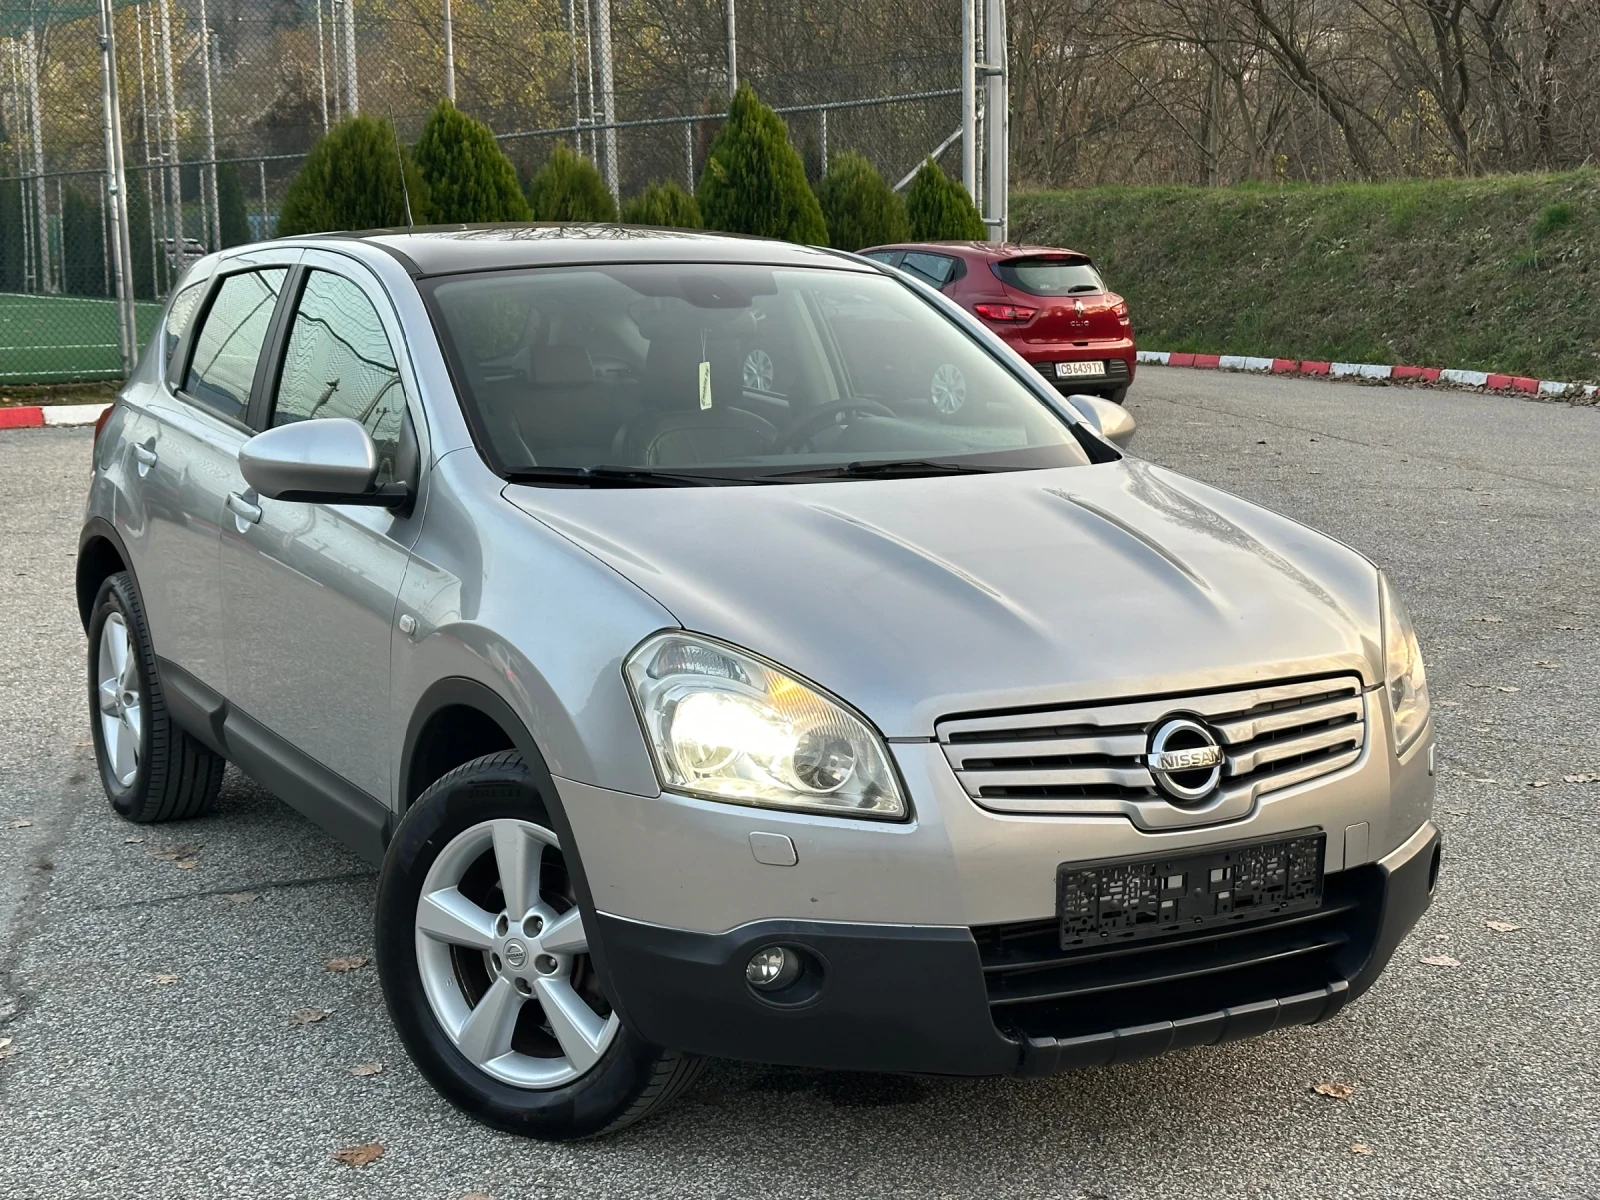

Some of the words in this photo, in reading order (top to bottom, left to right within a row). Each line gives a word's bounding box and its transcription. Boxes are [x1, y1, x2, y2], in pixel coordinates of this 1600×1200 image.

[1061, 364, 1073, 375] CB
[1073, 362, 1092, 374] 6439
[1093, 362, 1104, 373] TX
[1160, 747, 1221, 769] NISSAN
